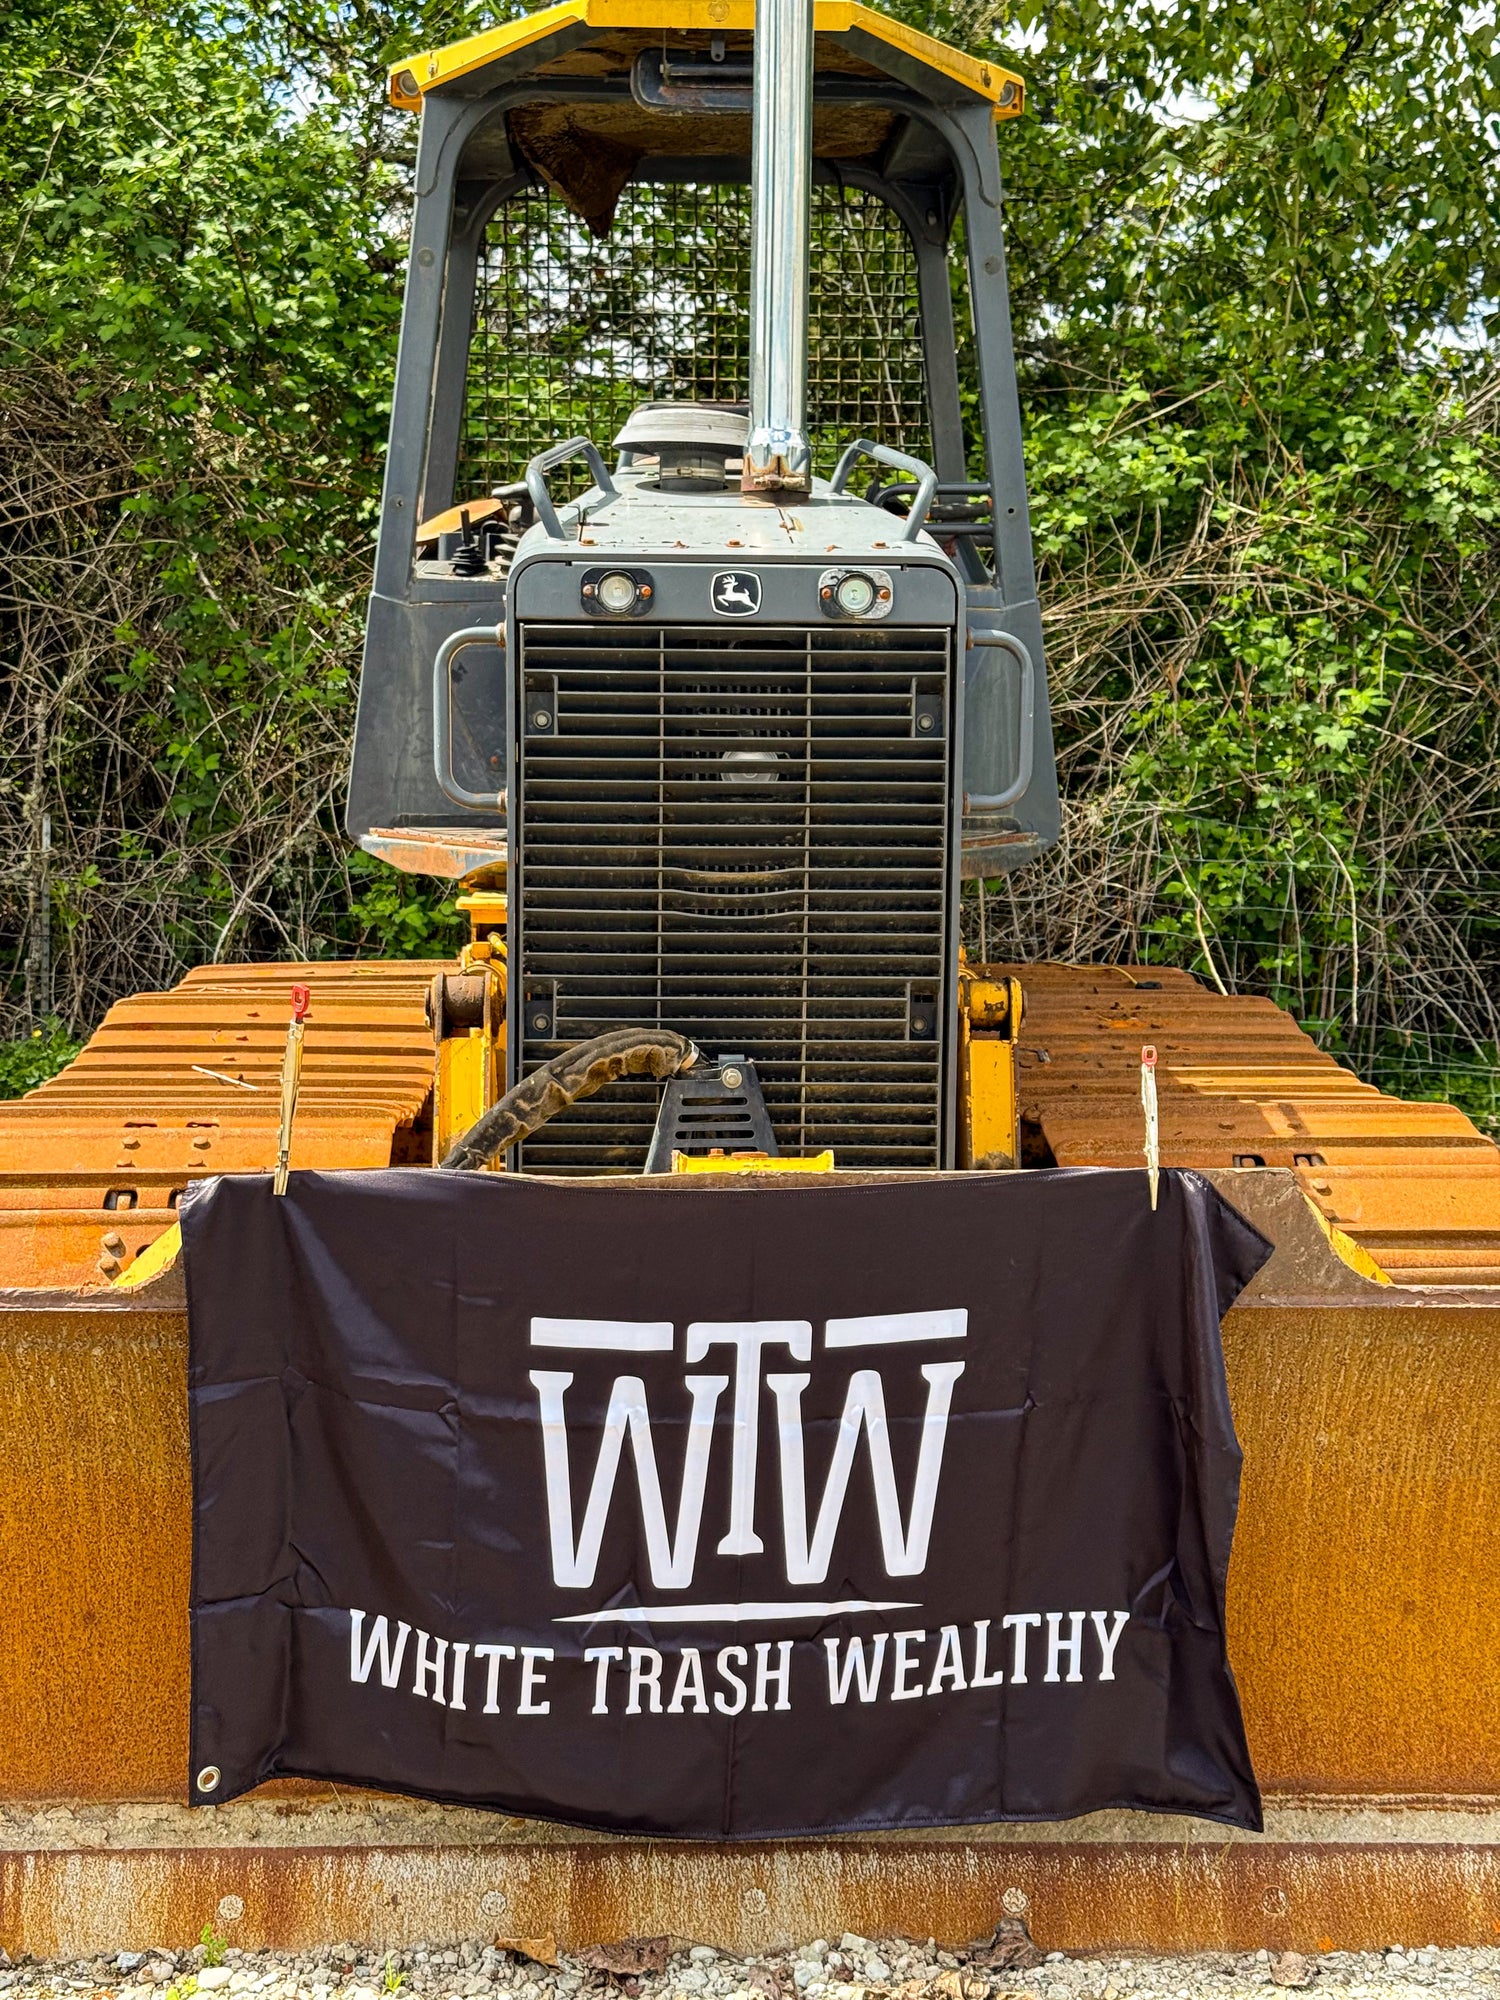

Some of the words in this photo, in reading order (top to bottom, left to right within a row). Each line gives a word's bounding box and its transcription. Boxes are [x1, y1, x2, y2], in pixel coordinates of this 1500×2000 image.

[528, 1308, 969, 1590] WTW
[348, 1607, 555, 1716] WHITE
[583, 1637, 794, 1716] TRASH
[824, 1609, 1132, 1706] WEALTHY
